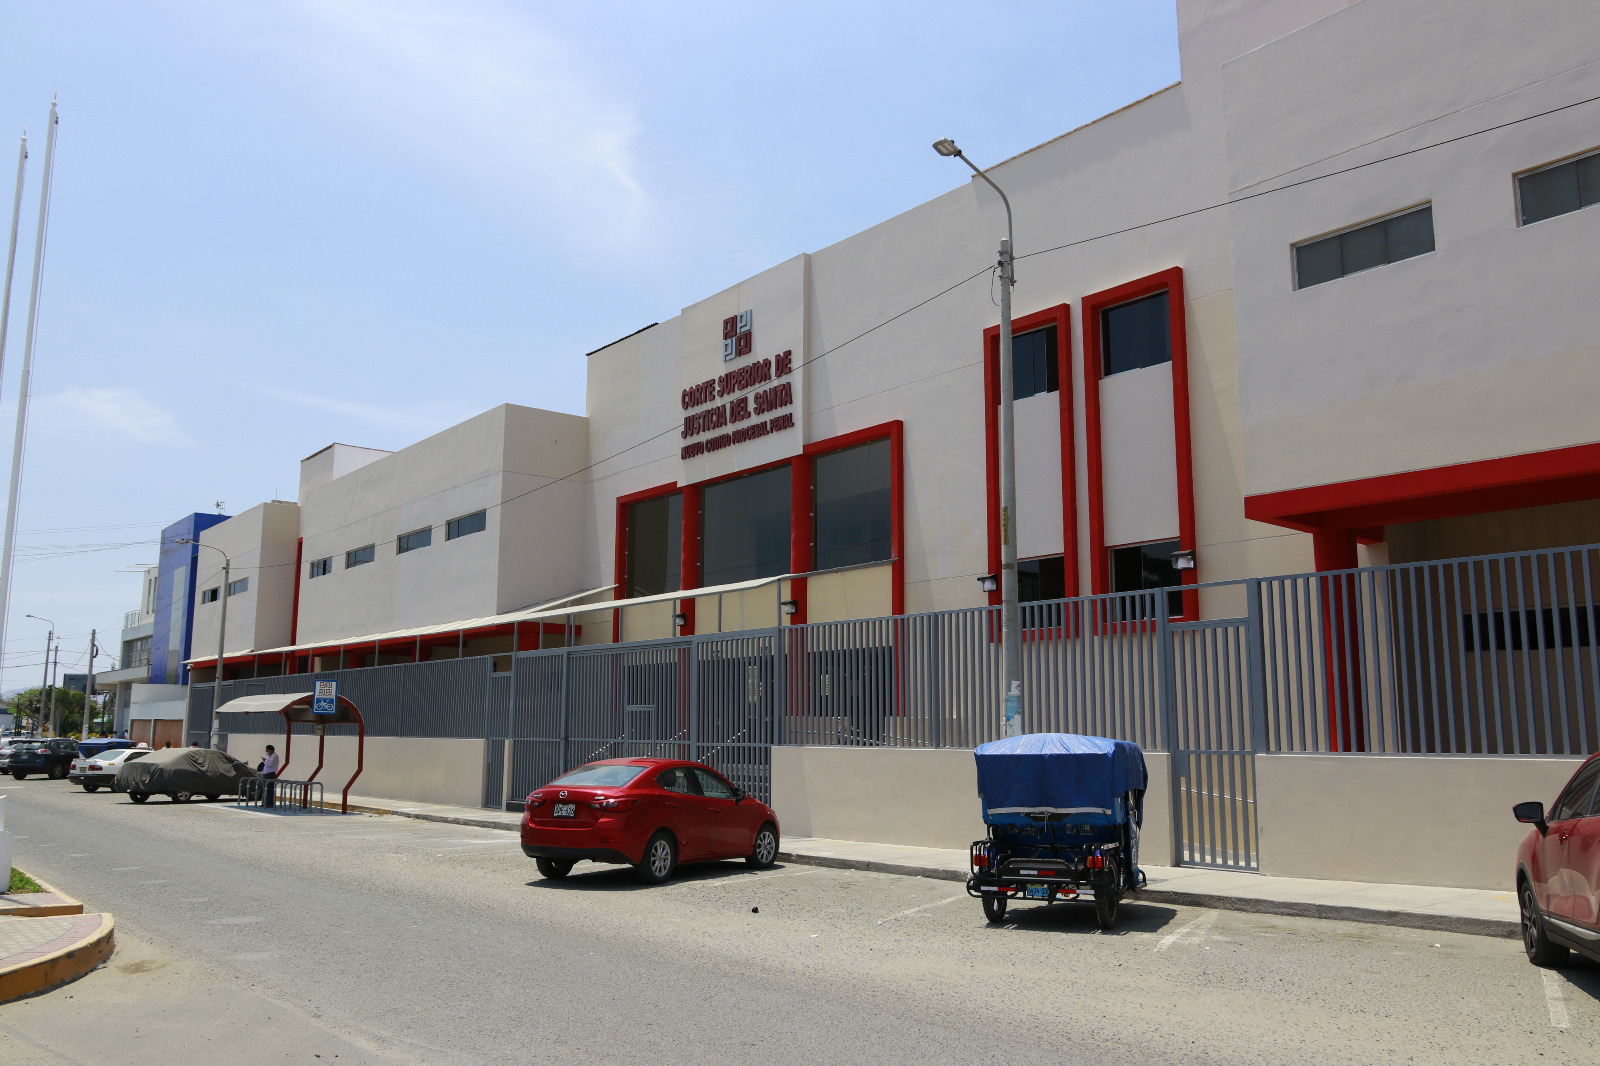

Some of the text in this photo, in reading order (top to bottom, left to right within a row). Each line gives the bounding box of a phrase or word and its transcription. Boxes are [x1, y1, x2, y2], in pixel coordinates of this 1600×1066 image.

[681, 350, 792, 410] CORTE SUPERIOR DE
[681, 382, 793, 439] JUSTICIA DEL SANTA
[681, 441, 704, 460] NUEVO
[732, 421, 769, 445] PROCESAL
[769, 413, 794, 433] PENAL
